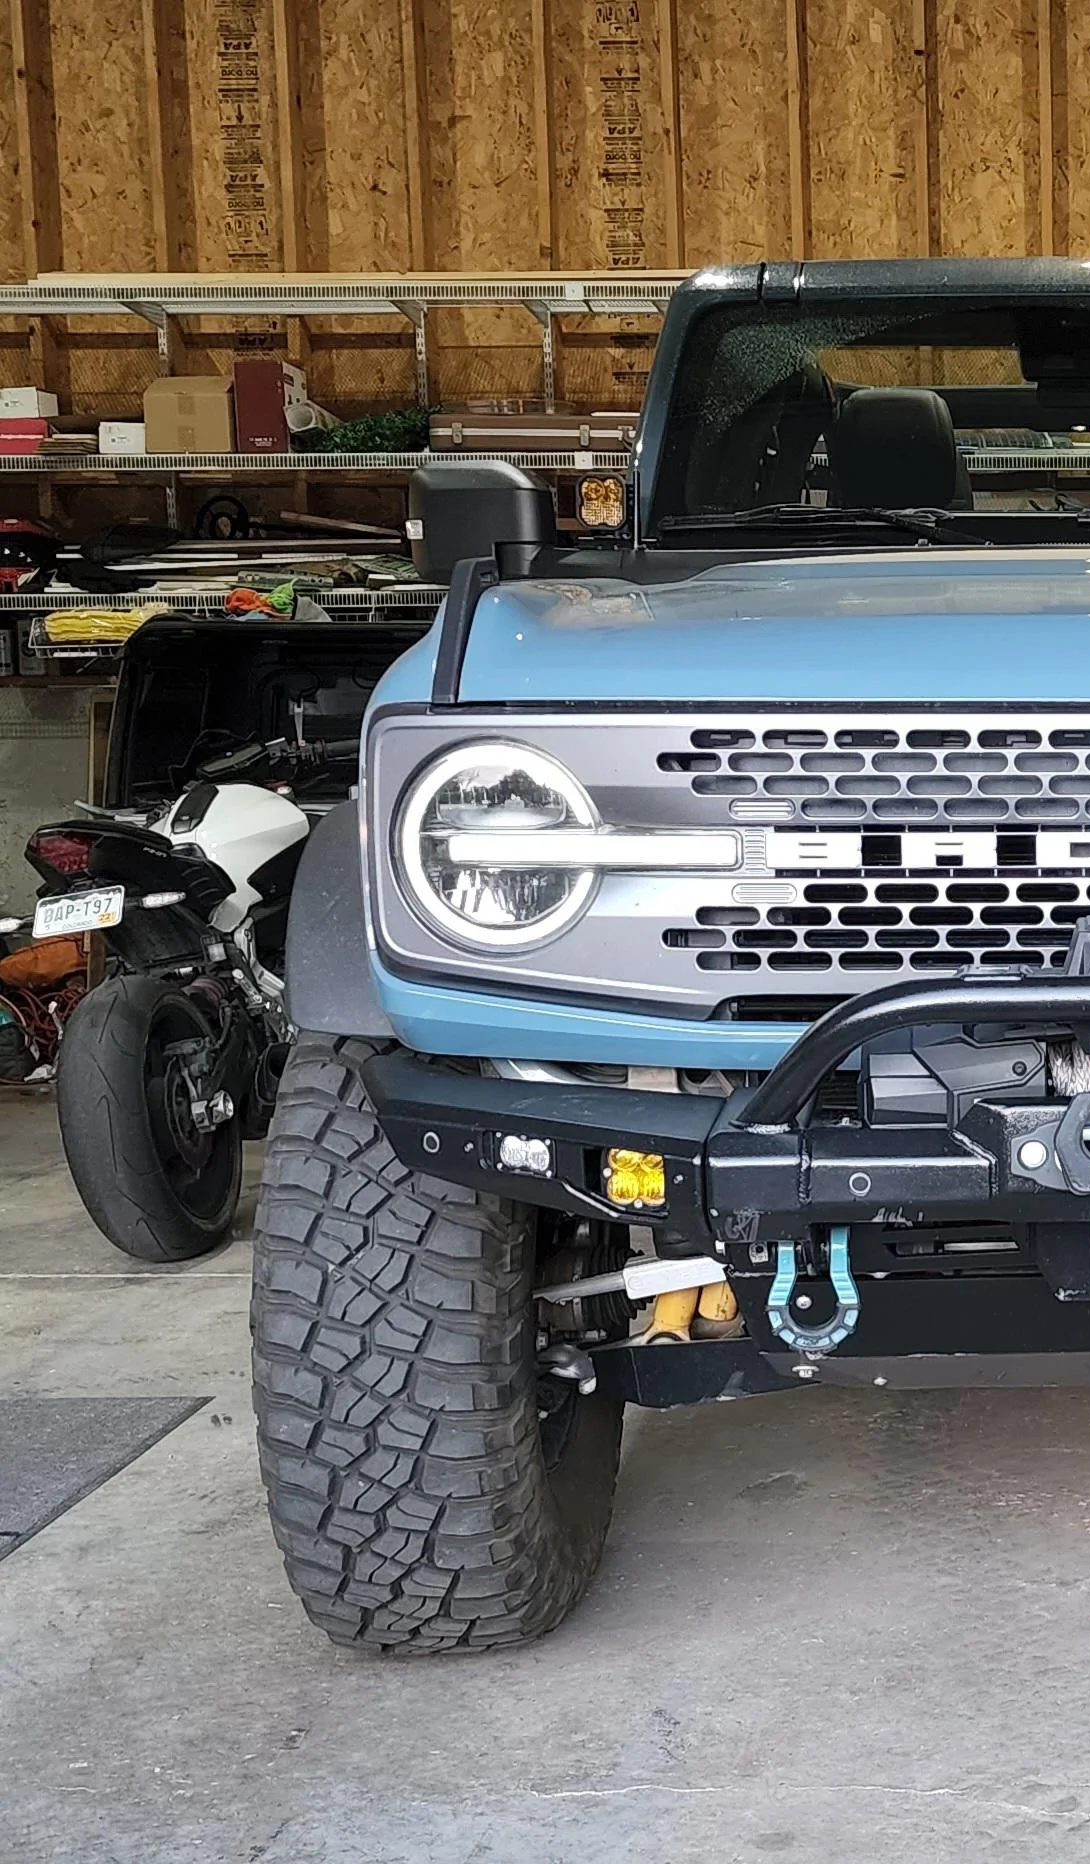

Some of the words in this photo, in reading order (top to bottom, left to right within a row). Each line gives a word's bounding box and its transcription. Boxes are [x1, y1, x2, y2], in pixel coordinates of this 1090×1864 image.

[608, 126, 637, 136] APA
[612, 256, 641, 266] APA
[43, 897, 113, 924] BAP-T97
